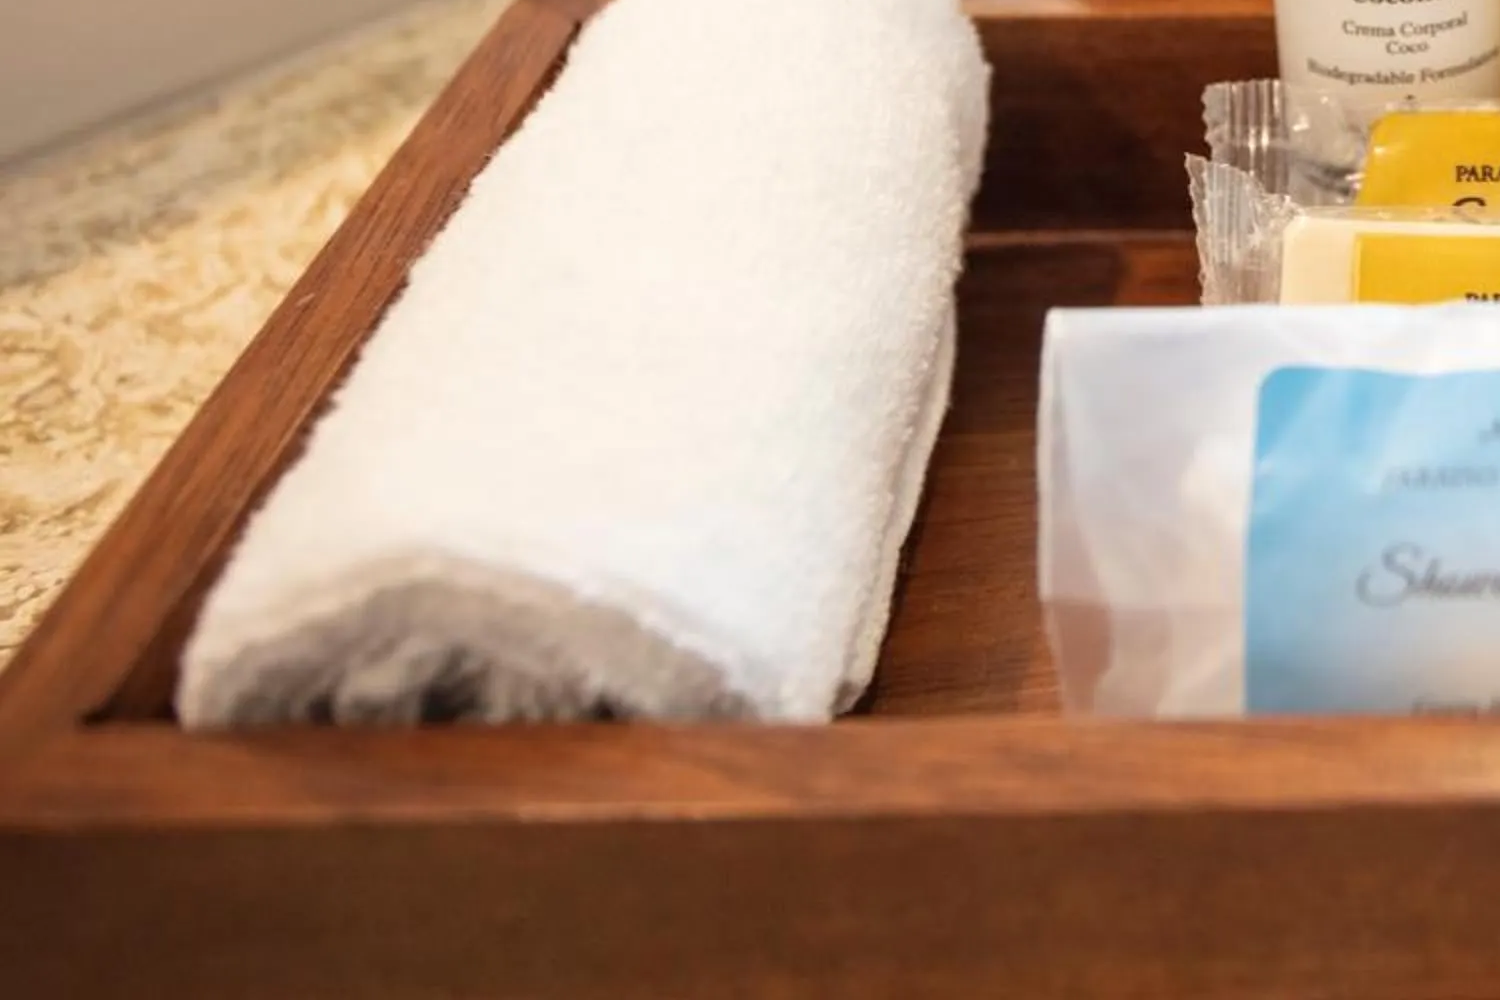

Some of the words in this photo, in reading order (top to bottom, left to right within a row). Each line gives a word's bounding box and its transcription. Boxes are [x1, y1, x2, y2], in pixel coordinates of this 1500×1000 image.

[1342, 19, 1396, 38] Crema
[1400, 11, 1469, 38] Corporal
[1385, 39, 1430, 56] Coco
